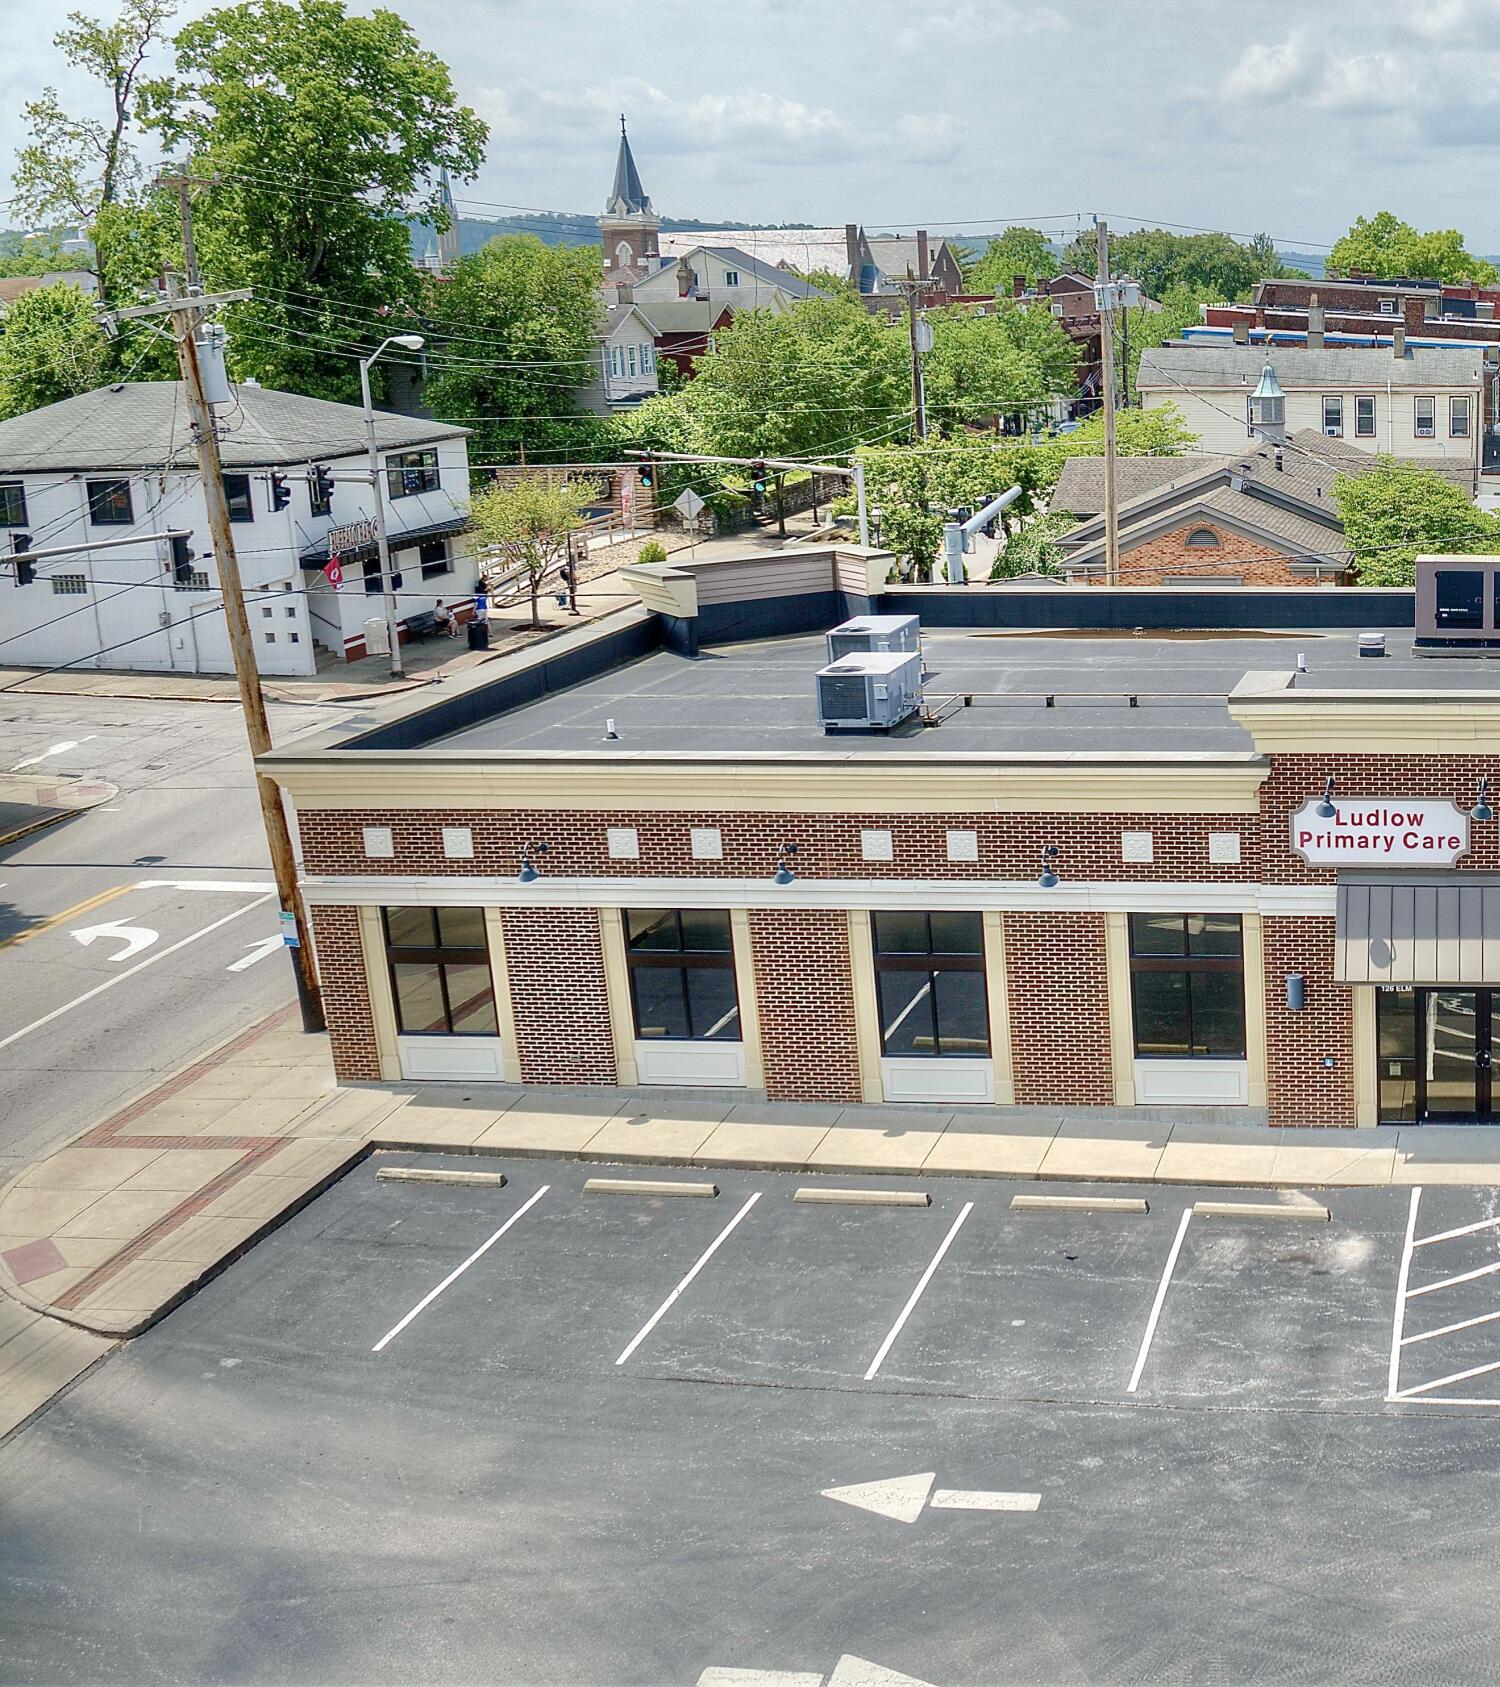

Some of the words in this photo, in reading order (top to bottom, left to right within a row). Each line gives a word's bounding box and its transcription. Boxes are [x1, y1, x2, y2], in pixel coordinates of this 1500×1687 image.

[1335, 809, 1424, 827] Ludlow
[1299, 831, 1395, 852] Primary
[1402, 831, 1461, 849] Care
